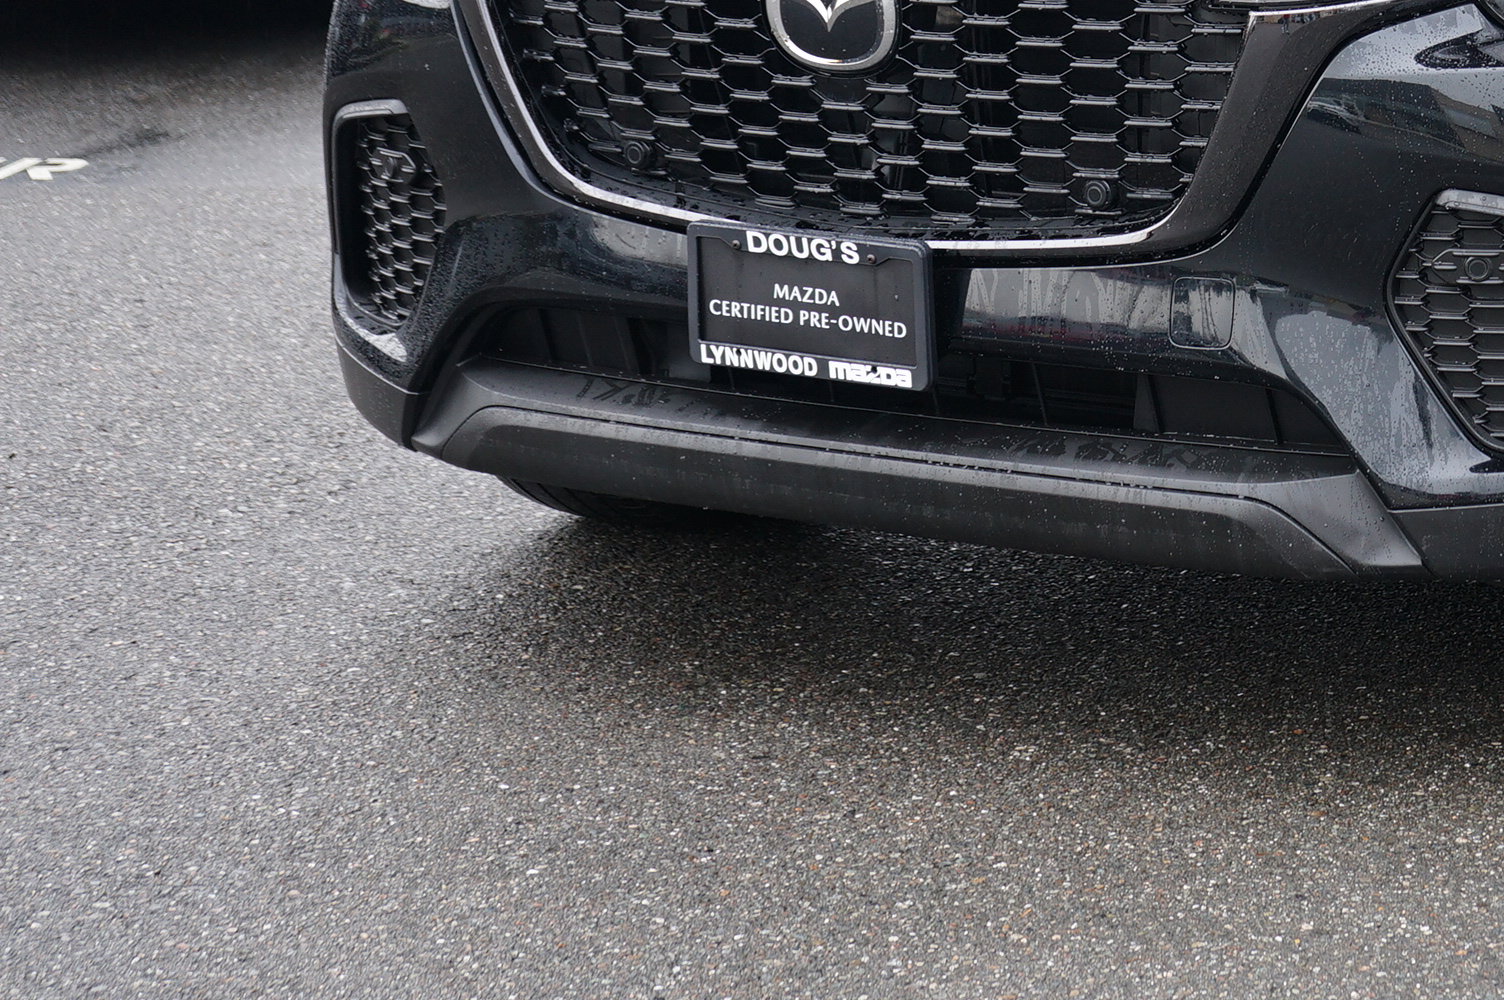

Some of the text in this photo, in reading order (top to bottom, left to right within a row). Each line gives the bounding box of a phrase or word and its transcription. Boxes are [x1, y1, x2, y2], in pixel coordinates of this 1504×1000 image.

[745, 230, 860, 265] DOUG'S
[773, 283, 840, 307] MAZDA
[709, 299, 907, 339] CERTIFIED PRE-OWNED
[700, 344, 913, 388] LYNNWOOD mazda
